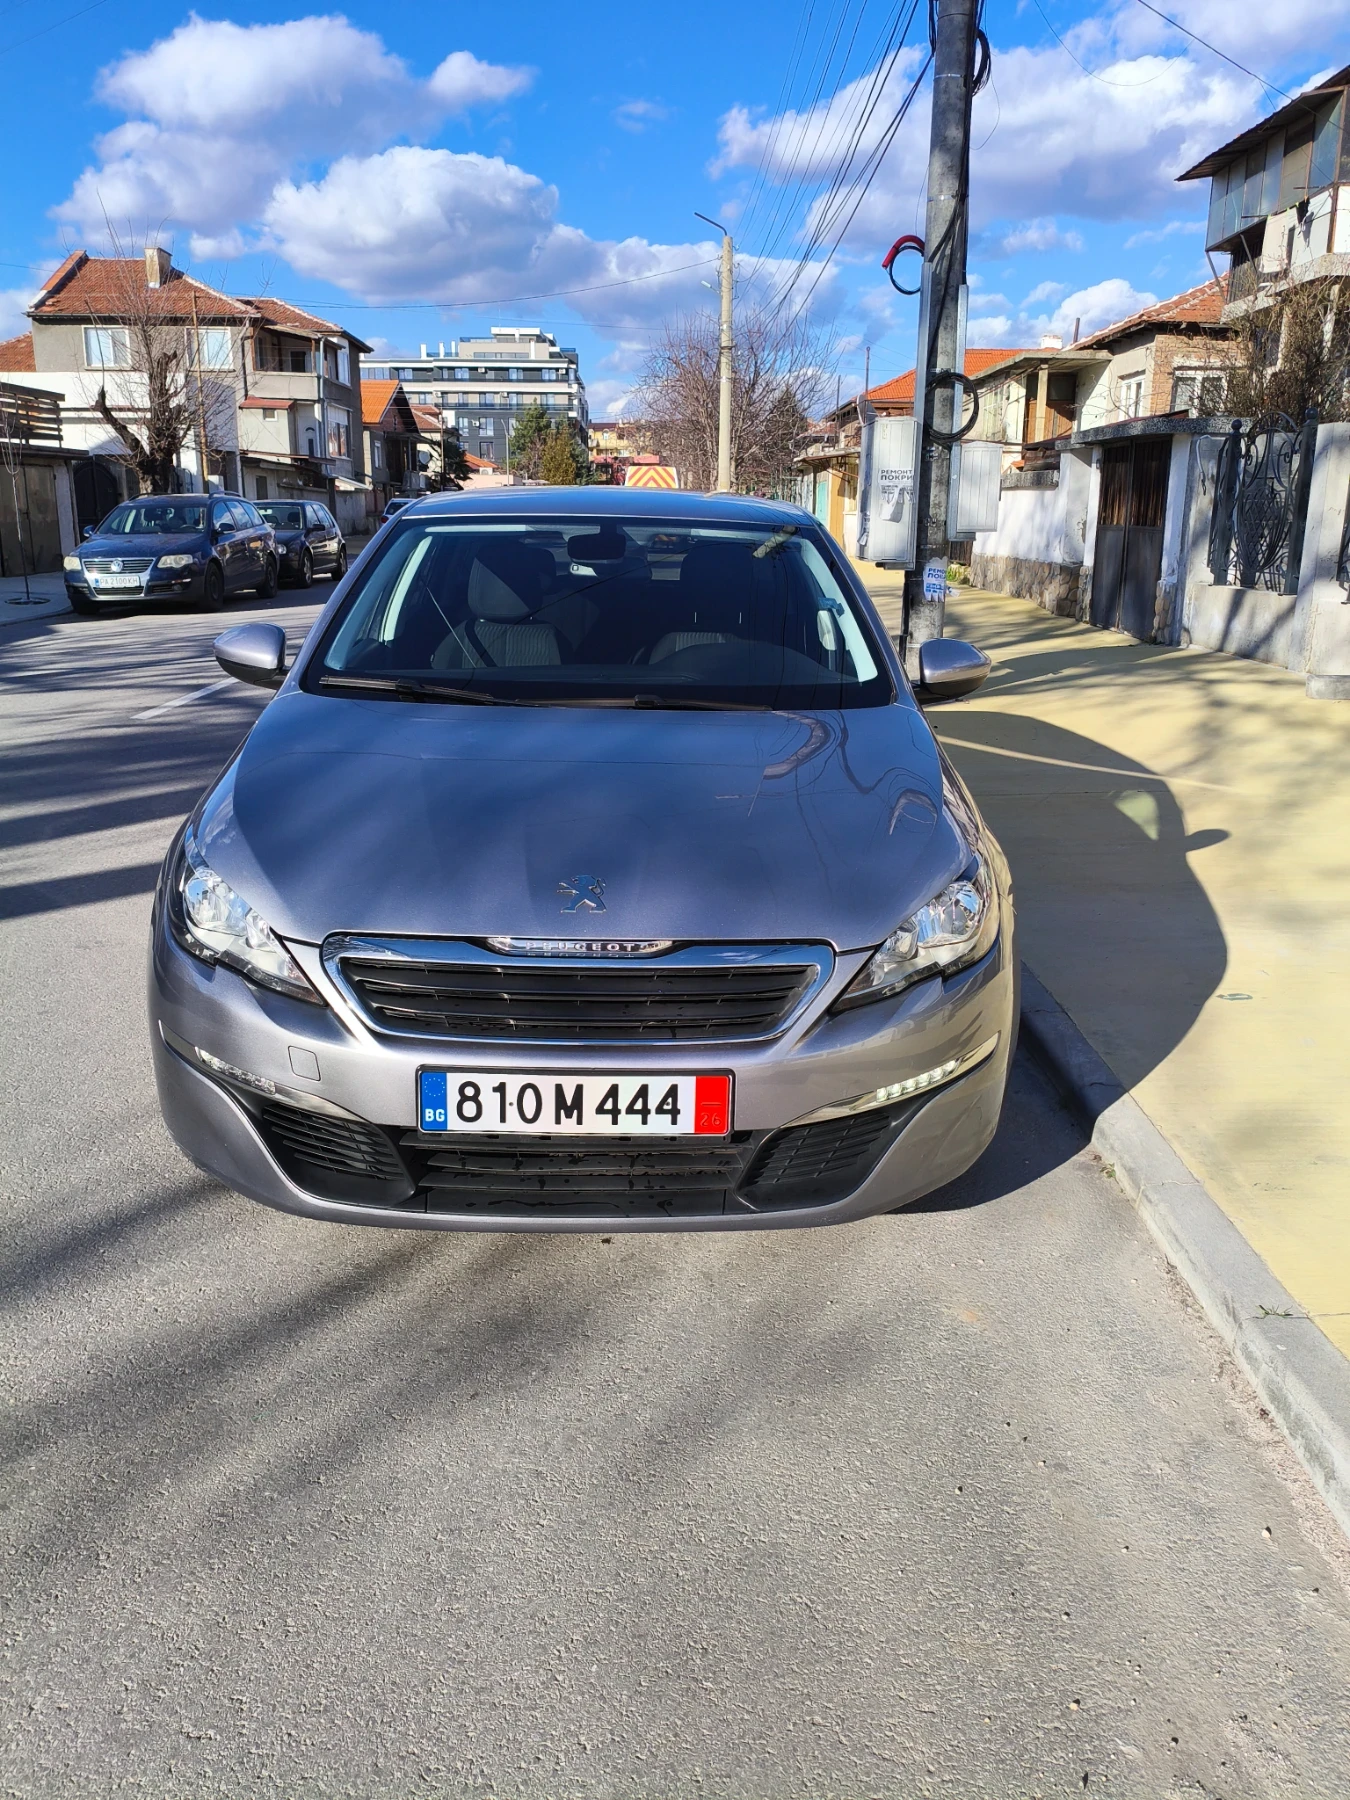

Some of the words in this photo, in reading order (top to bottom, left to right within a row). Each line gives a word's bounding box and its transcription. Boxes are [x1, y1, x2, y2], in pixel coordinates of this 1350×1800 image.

[526, 942, 635, 952] PEUGEOT
[456, 1081, 543, 1124] 810
[554, 1083, 584, 1125] M
[595, 1083, 681, 1126] 444
[424, 1109, 445, 1123] BG
[700, 1112, 722, 1127] 26
